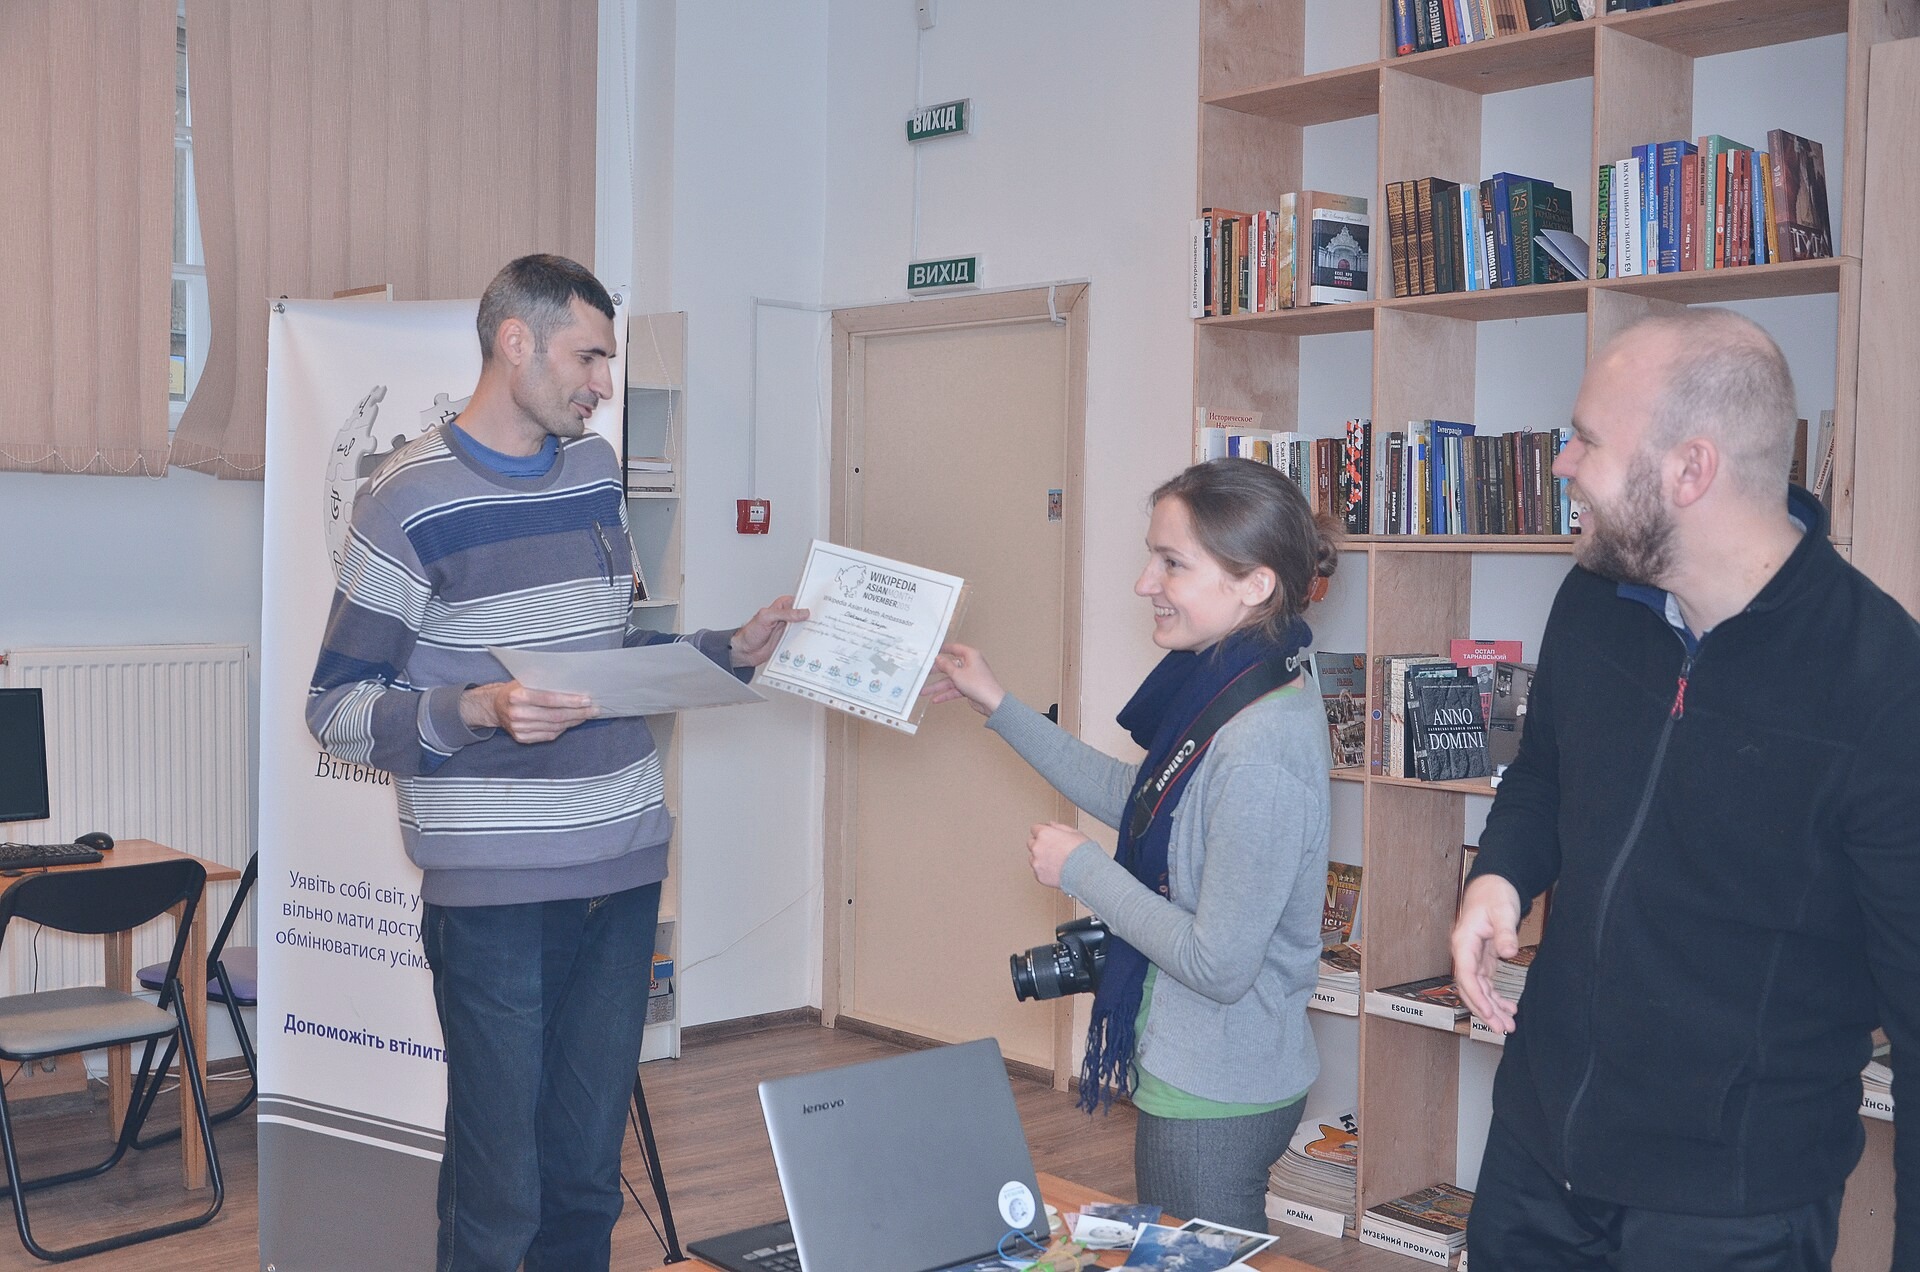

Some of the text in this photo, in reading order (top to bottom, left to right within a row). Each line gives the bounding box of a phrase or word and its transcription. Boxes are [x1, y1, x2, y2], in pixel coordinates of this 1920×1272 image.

[913, 106, 956, 134] ВИХІД
[1512, 192, 1528, 212] 25
[913, 262, 969, 285] ВИХІД
[1624, 262, 1632, 273] 63
[1209, 412, 1253, 423] Историческое
[870, 571, 917, 593] WIKIPEDIA
[823, 594, 848, 607] Wikipedia
[848, 602, 863, 612] Asian
[863, 606, 881, 617] Month
[881, 612, 915, 627] Ambassador
[863, 592, 898, 608] NOVEMBER
[1433, 708, 1473, 726] ANNO
[1428, 732, 1484, 750] DOMINI
[315, 751, 391, 786] Вільна
[1155, 738, 1195, 792] Canon
[289, 870, 421, 911] Уявіть собі світ, у
[283, 901, 422, 942] вільно мати досту
[275, 929, 386, 962] обмінюватися
[1391, 1003, 1424, 1017] ESQUIRE
[284, 1013, 385, 1050] Допоможіть
[802, 1098, 845, 1115] lenovo
[1861, 1098, 1895, 1113] ЇНСЬ
[1286, 1208, 1314, 1223] КРАЇНА
[1362, 1227, 1446, 1260] МУЗЕЙНИЙ ПРОВУЛОК
